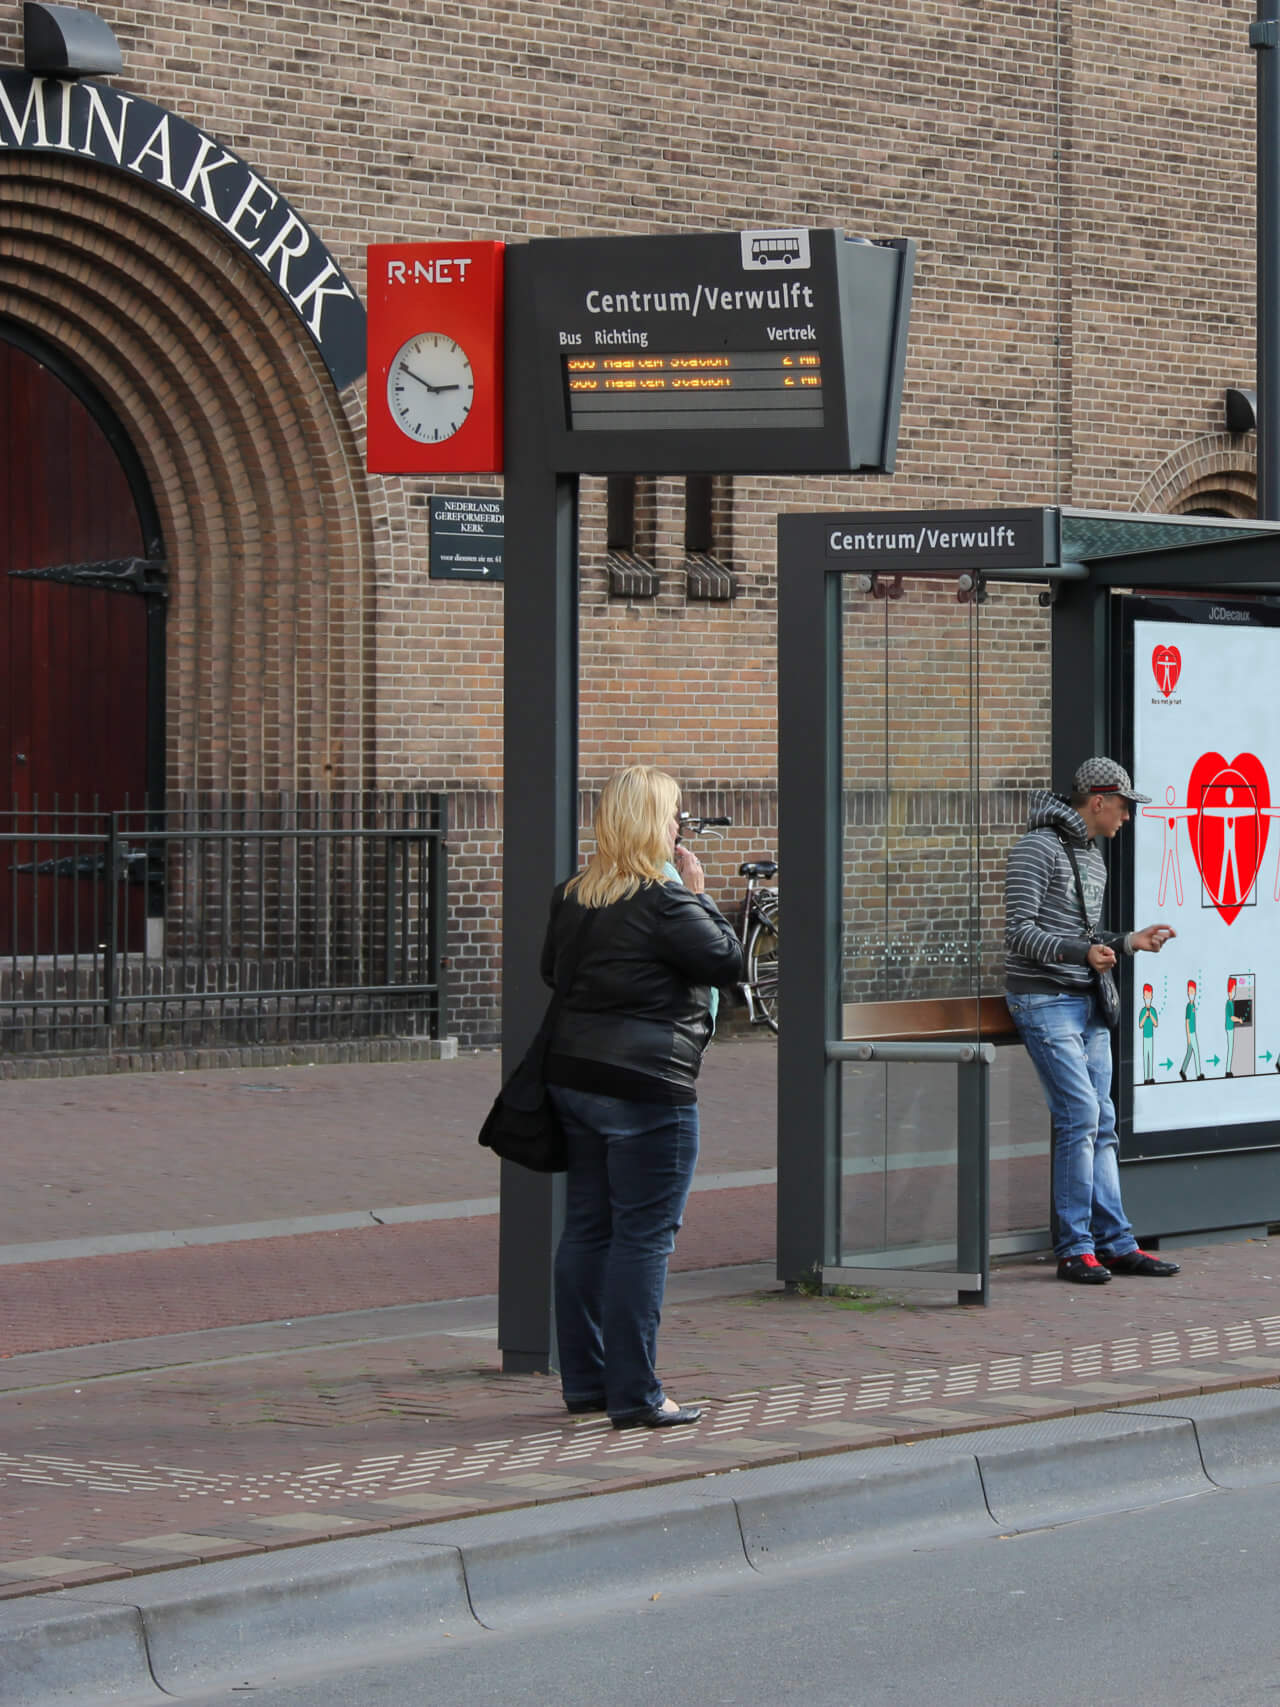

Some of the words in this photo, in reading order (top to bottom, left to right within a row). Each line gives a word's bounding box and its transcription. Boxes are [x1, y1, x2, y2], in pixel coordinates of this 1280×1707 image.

[586, 282, 815, 317] Centrum/Verwulft
[559, 331, 582, 346] Bus
[594, 328, 649, 348] Richting
[766, 325, 817, 341] Vertrek
[444, 501, 500, 513] NEDERLANDS
[460, 522, 485, 533] KERK
[829, 526, 1016, 554] Centrum/Verwulft
[1208, 607, 1251, 622] JCDecaux
